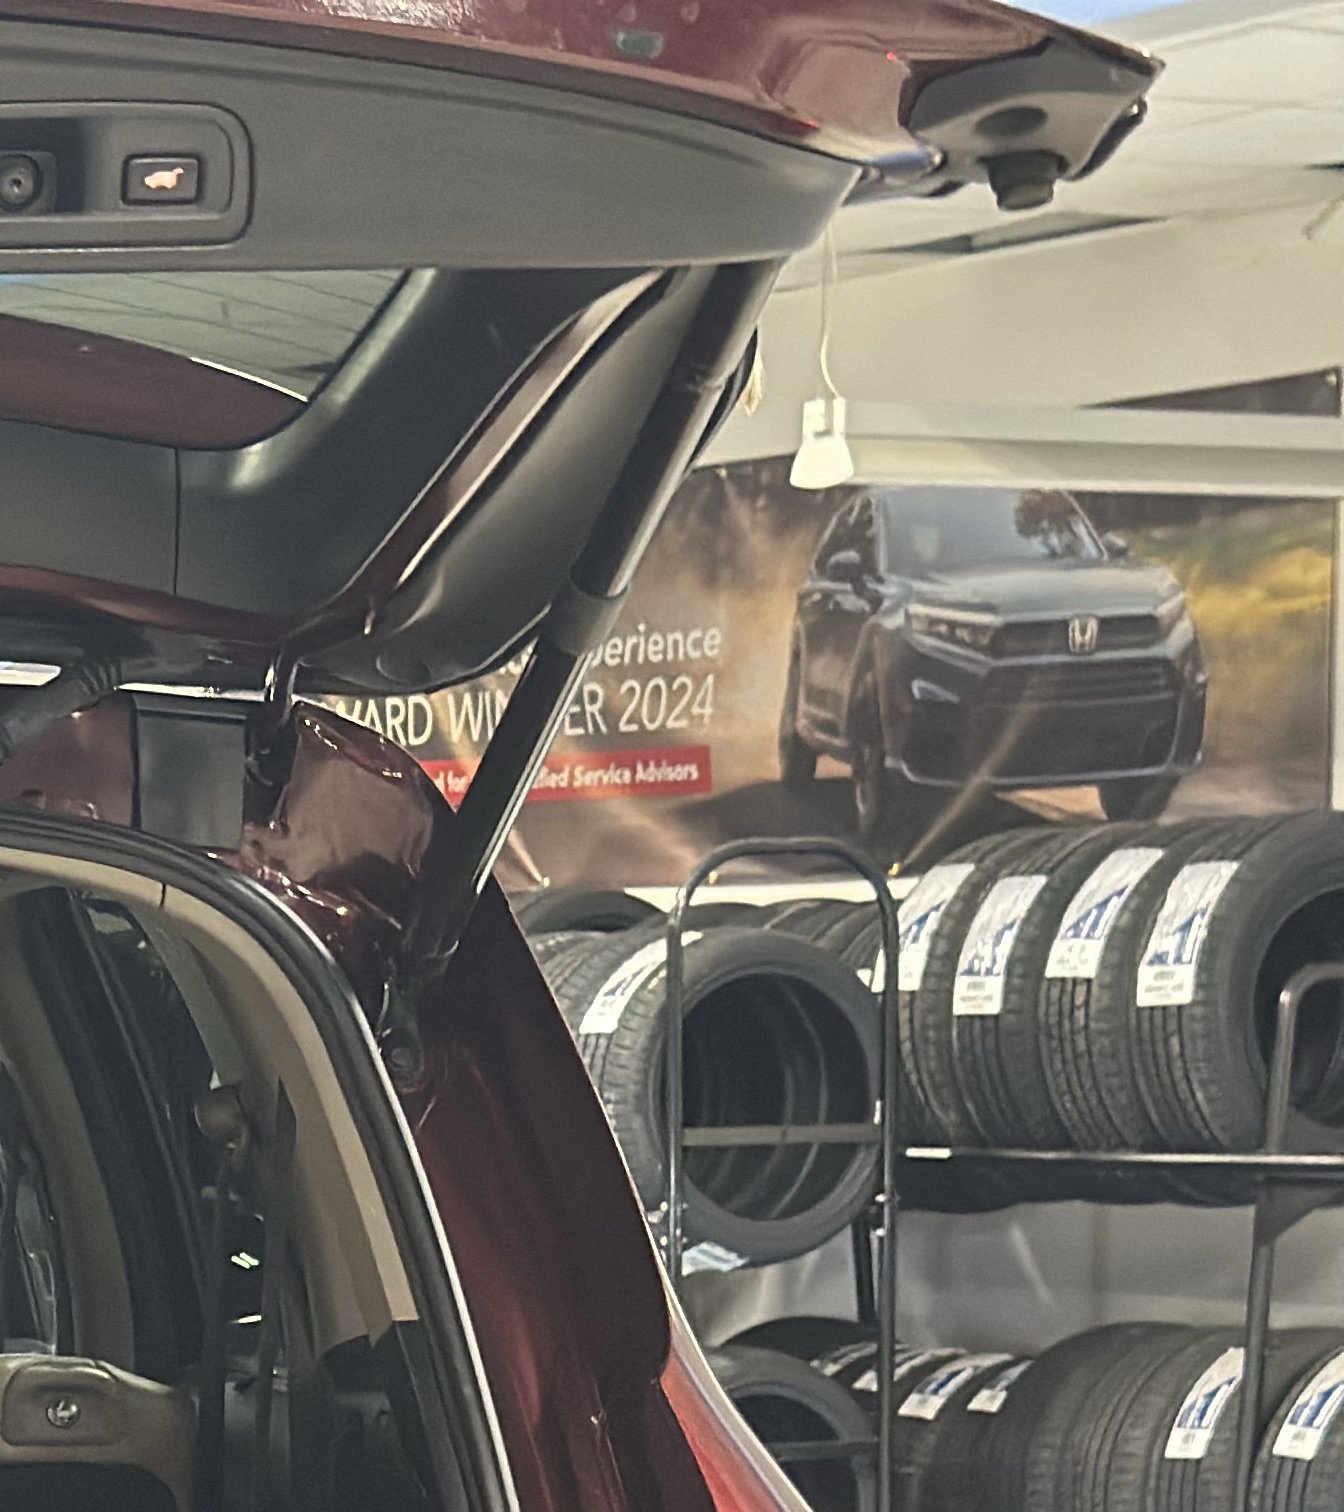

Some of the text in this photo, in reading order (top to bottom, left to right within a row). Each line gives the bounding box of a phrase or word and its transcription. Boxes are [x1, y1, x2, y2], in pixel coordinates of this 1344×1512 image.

[591, 622, 722, 668] erience
[334, 673, 715, 747] ARD WIER 2024
[573, 763, 630, 786] Service
[635, 761, 700, 784] Advisors
